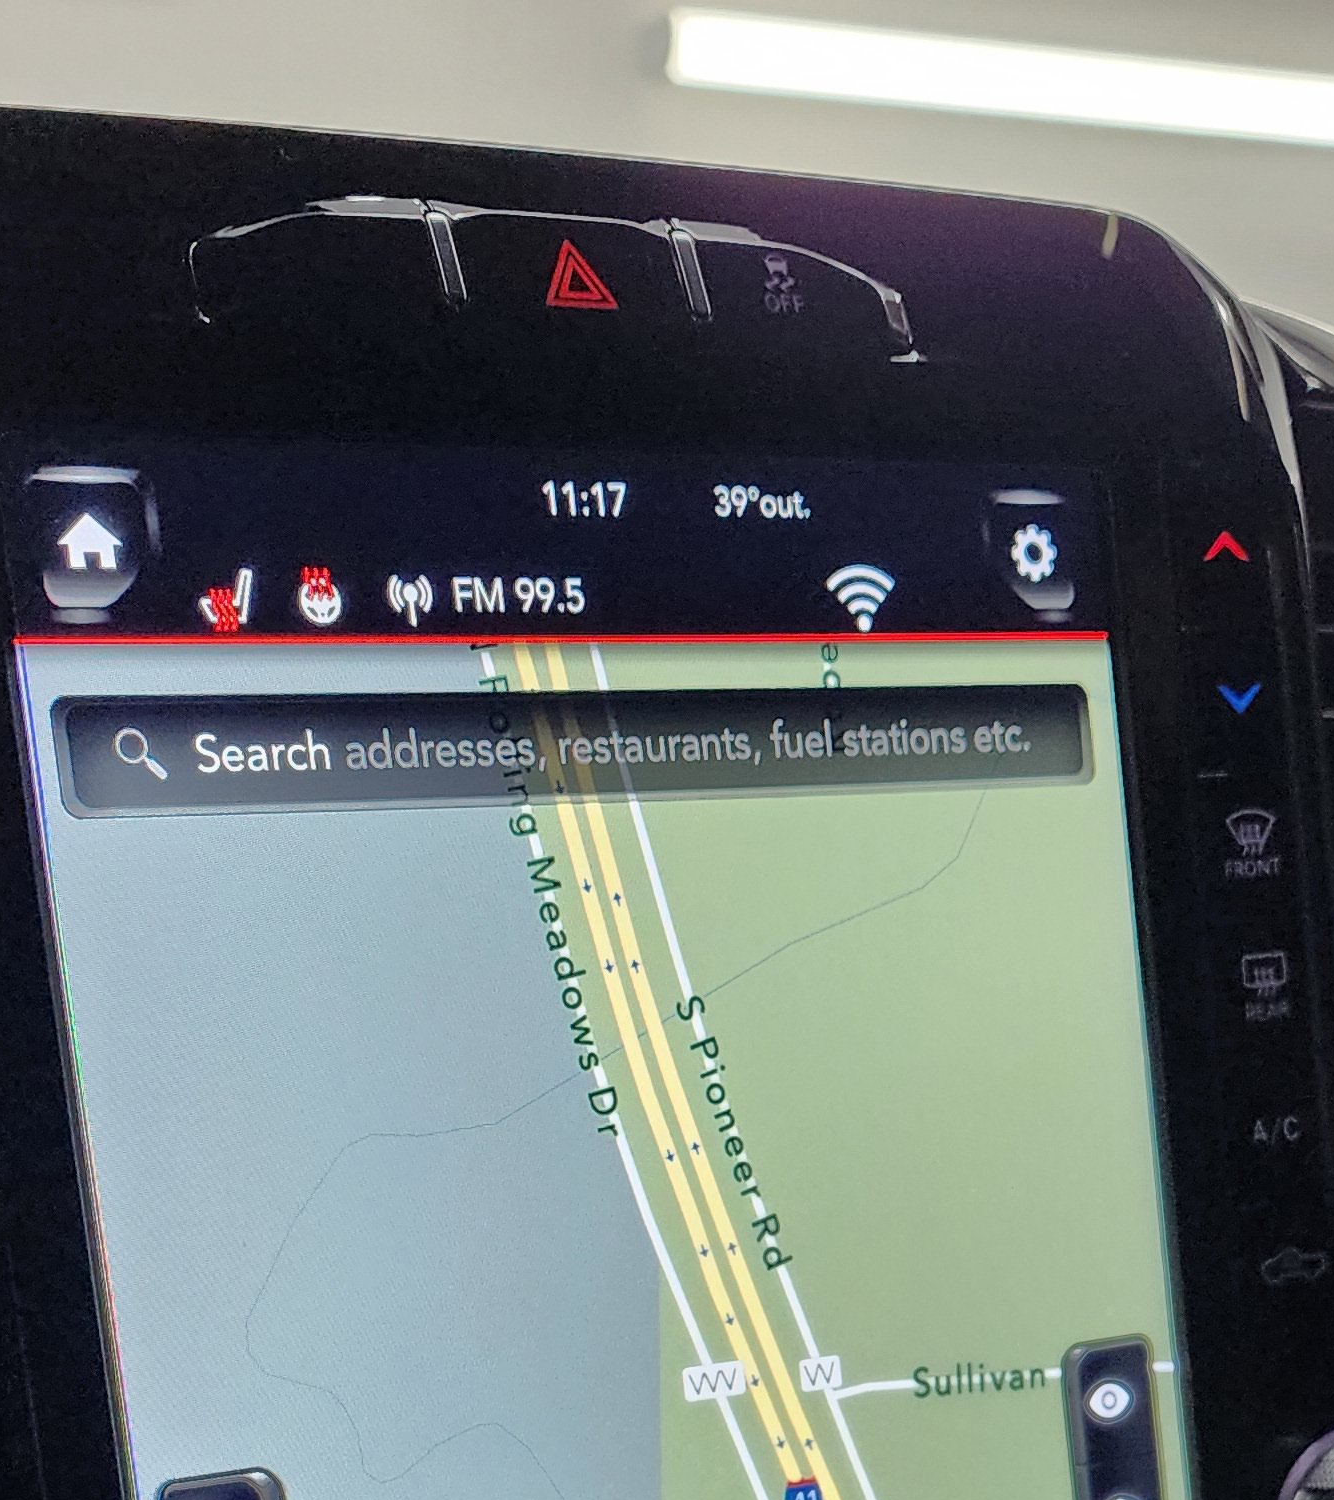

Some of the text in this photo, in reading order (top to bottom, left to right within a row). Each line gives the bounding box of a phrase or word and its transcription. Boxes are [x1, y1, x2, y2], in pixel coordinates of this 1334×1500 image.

[764, 293, 804, 313] OFF
[541, 479, 627, 518] 11:17
[452, 577, 586, 615] FM 99.5
[194, 718, 1032, 773] Search addresses, restaurants, fuel stations etc.
[1225, 857, 1281, 877] FRONT
[526, 855, 600, 1071] Meadows
[587, 1086, 620, 1138] Dr
[677, 995, 793, 1271] S Pioneer Rd
[1254, 1117, 1299, 1145] A/C
[913, 1362, 1046, 1398] Sullivan
